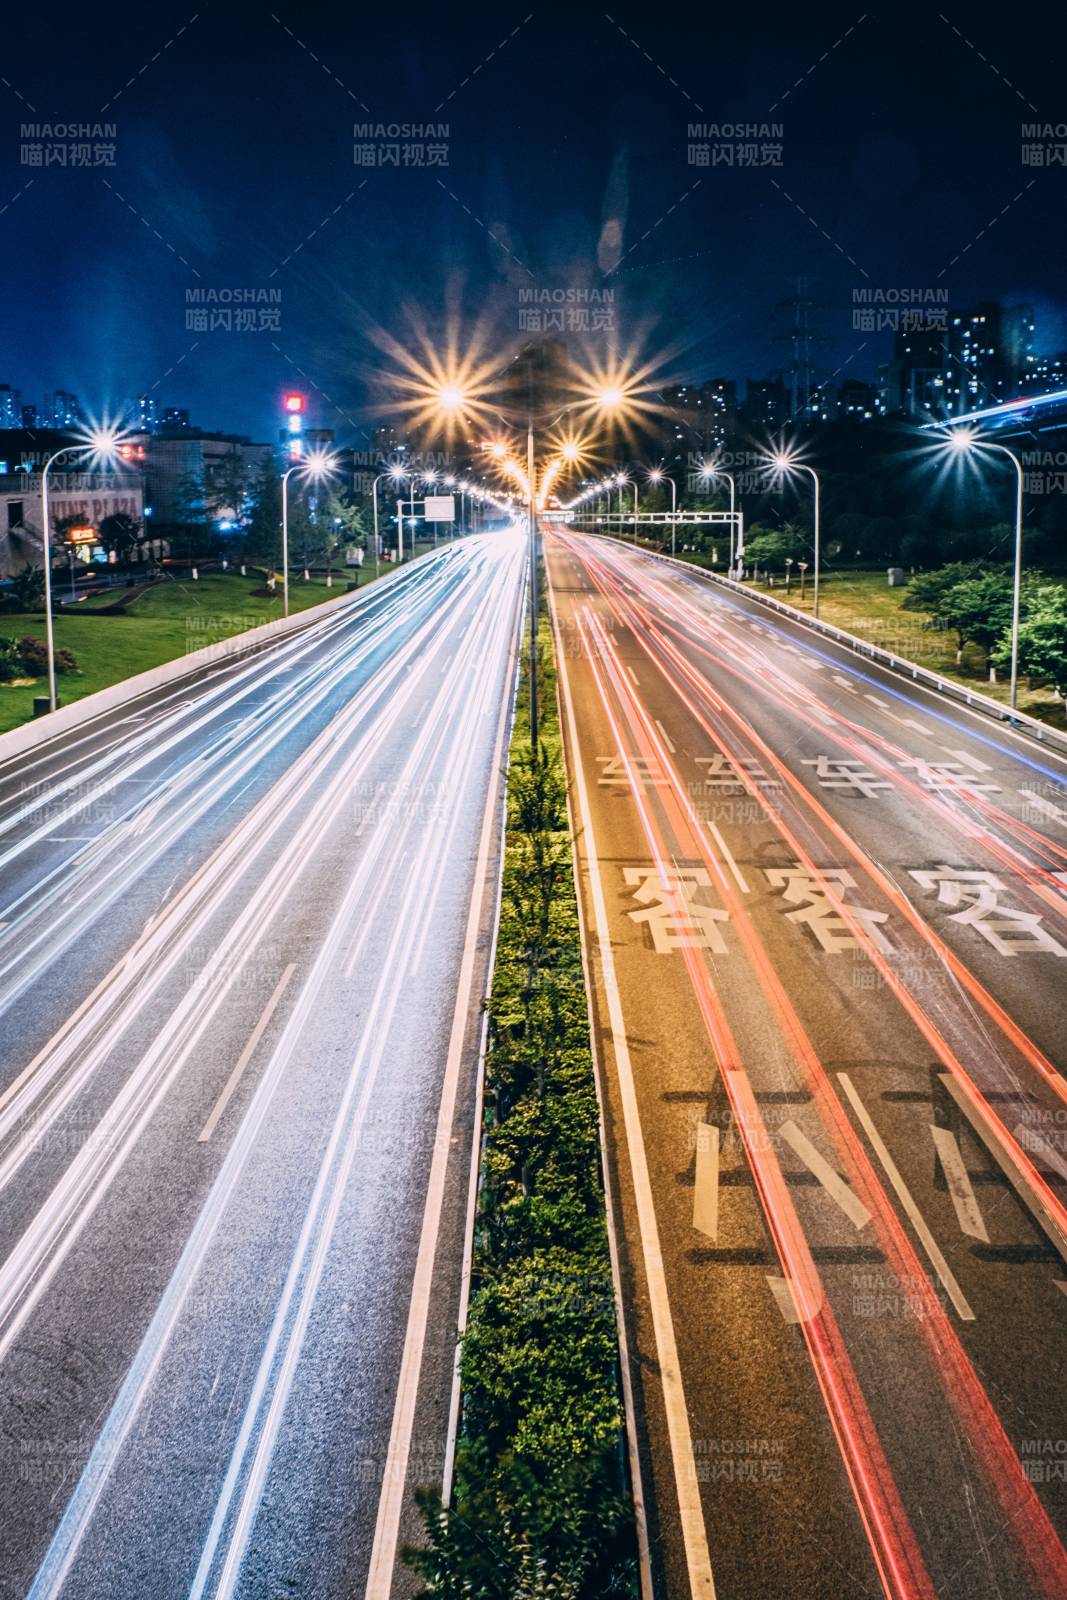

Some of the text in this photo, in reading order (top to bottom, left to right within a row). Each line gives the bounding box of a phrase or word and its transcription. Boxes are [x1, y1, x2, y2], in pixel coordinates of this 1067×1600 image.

[694, 753, 782, 796] 车
[800, 755, 895, 799] 车
[622, 864, 729, 954] 客
[763, 862, 899, 954] 客
[908, 865, 1067, 957] 客
